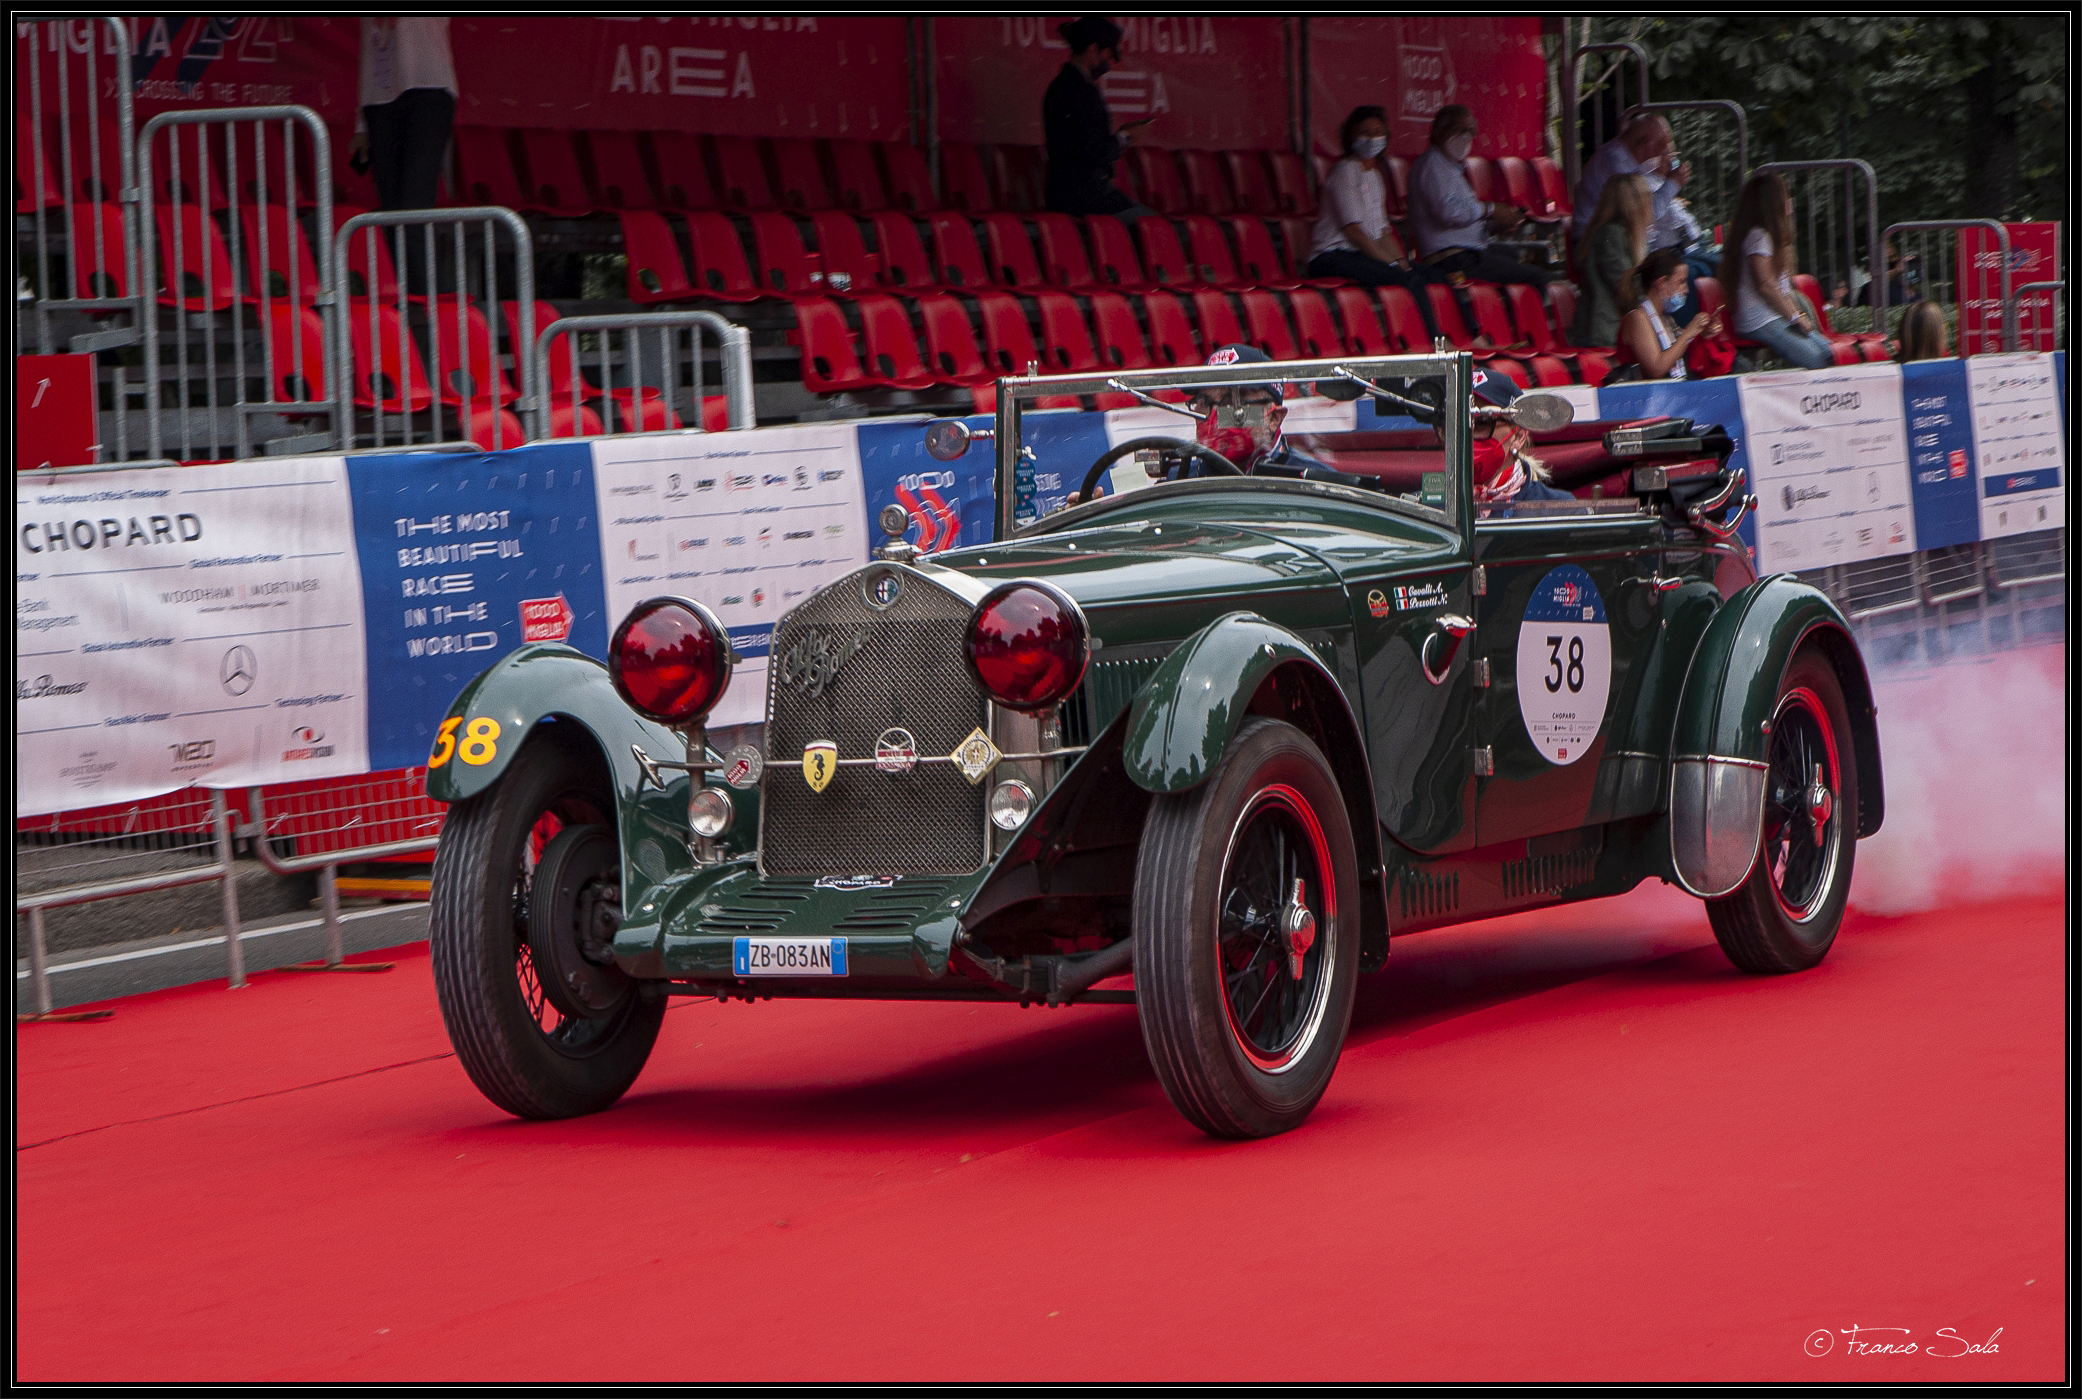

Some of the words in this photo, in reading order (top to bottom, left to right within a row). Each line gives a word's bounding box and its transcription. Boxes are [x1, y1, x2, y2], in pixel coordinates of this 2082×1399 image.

[610, 43, 756, 99] AREA
[209, 82, 237, 103] THE
[241, 84, 294, 105] FUTURE
[20, 512, 203, 554] CHOPARD
[394, 514, 453, 538] THE
[456, 510, 511, 533] MOST
[397, 539, 524, 568] BEAUTIFUL
[402, 572, 474, 598] RACE
[404, 609, 428, 629] IN
[431, 601, 489, 624] THE
[406, 630, 498, 659] WORLD
[1543, 635, 1586, 694] 38
[428, 715, 502, 770] 38
